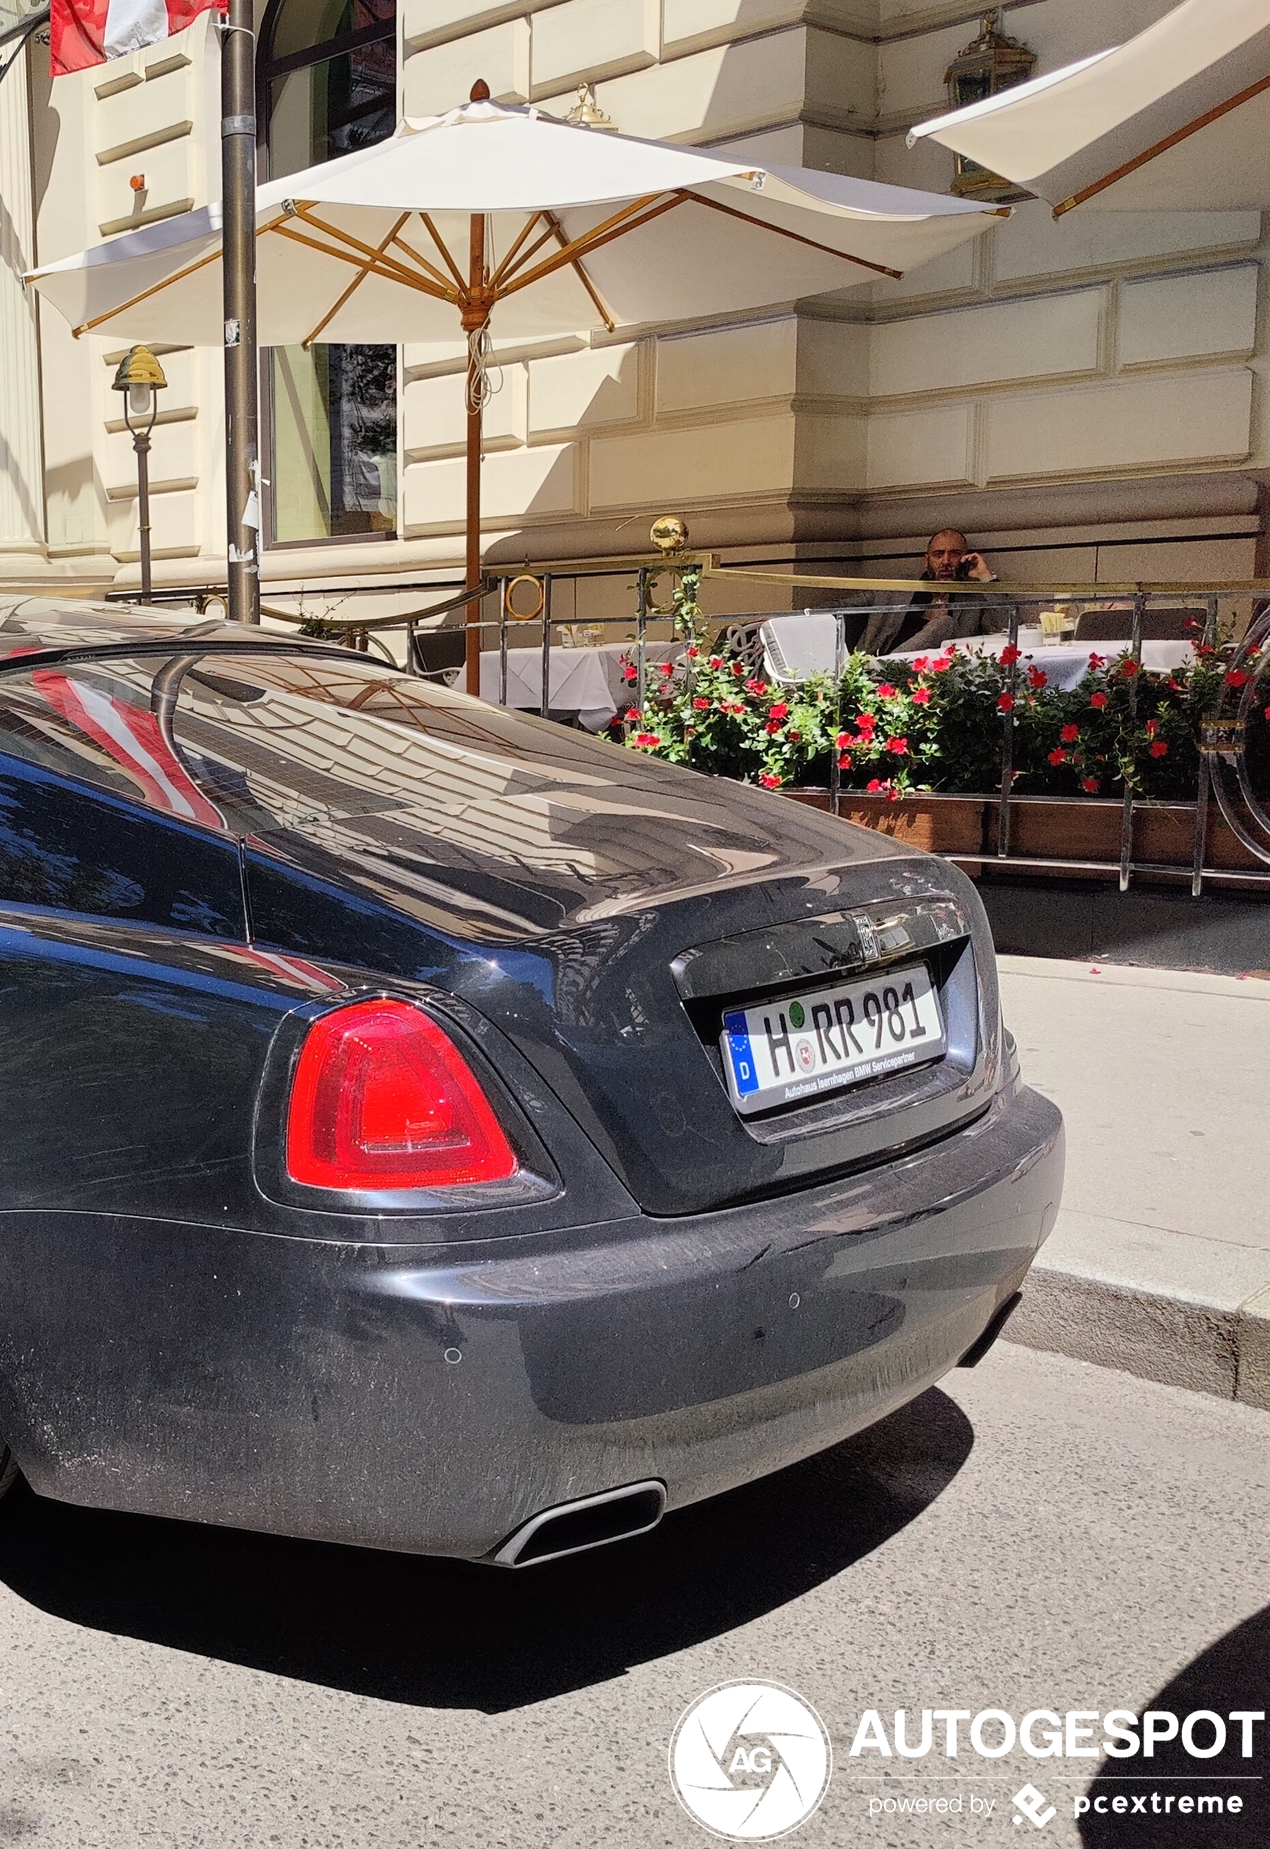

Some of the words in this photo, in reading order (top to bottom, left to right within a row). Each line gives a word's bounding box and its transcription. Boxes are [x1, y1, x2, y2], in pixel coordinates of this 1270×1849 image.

[764, 1013, 796, 1077] H
[811, 997, 864, 1065] RR
[862, 982, 927, 1049] 981
[740, 1062, 751, 1081] D
[785, 1081, 818, 1099] Autohaus
[817, 1071, 855, 1090] Isernhagen
[854, 1064, 872, 1080] BMW
[872, 1051, 916, 1072] Servicepartner
